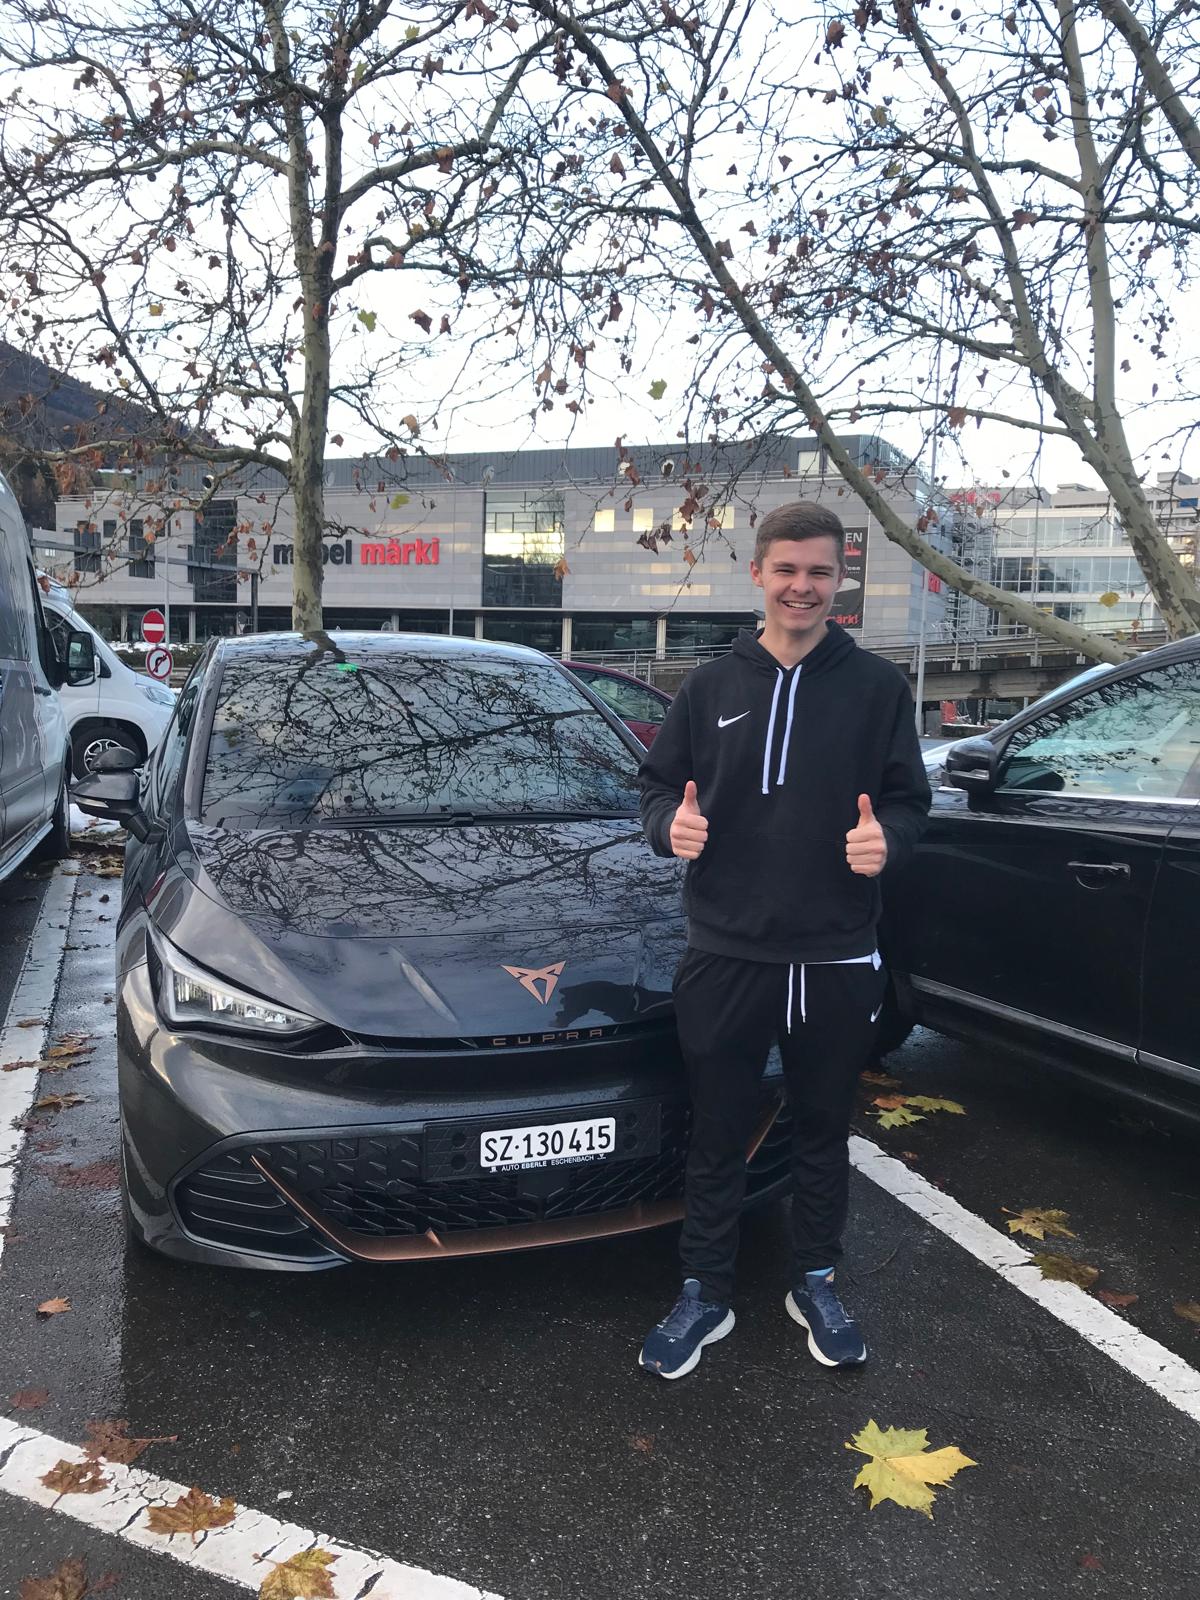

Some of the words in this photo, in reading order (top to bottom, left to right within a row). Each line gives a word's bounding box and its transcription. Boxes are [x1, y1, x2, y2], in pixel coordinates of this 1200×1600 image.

[845, 532, 863, 543] EN
[273, 539, 353, 565] mel
[360, 537, 441, 565] märki
[492, 1028, 603, 1046] CUPRA
[501, 1163, 520, 1172] AUTO
[521, 1160, 547, 1170] EBERLE
[551, 1154, 595, 1166] ESCHENBACH
